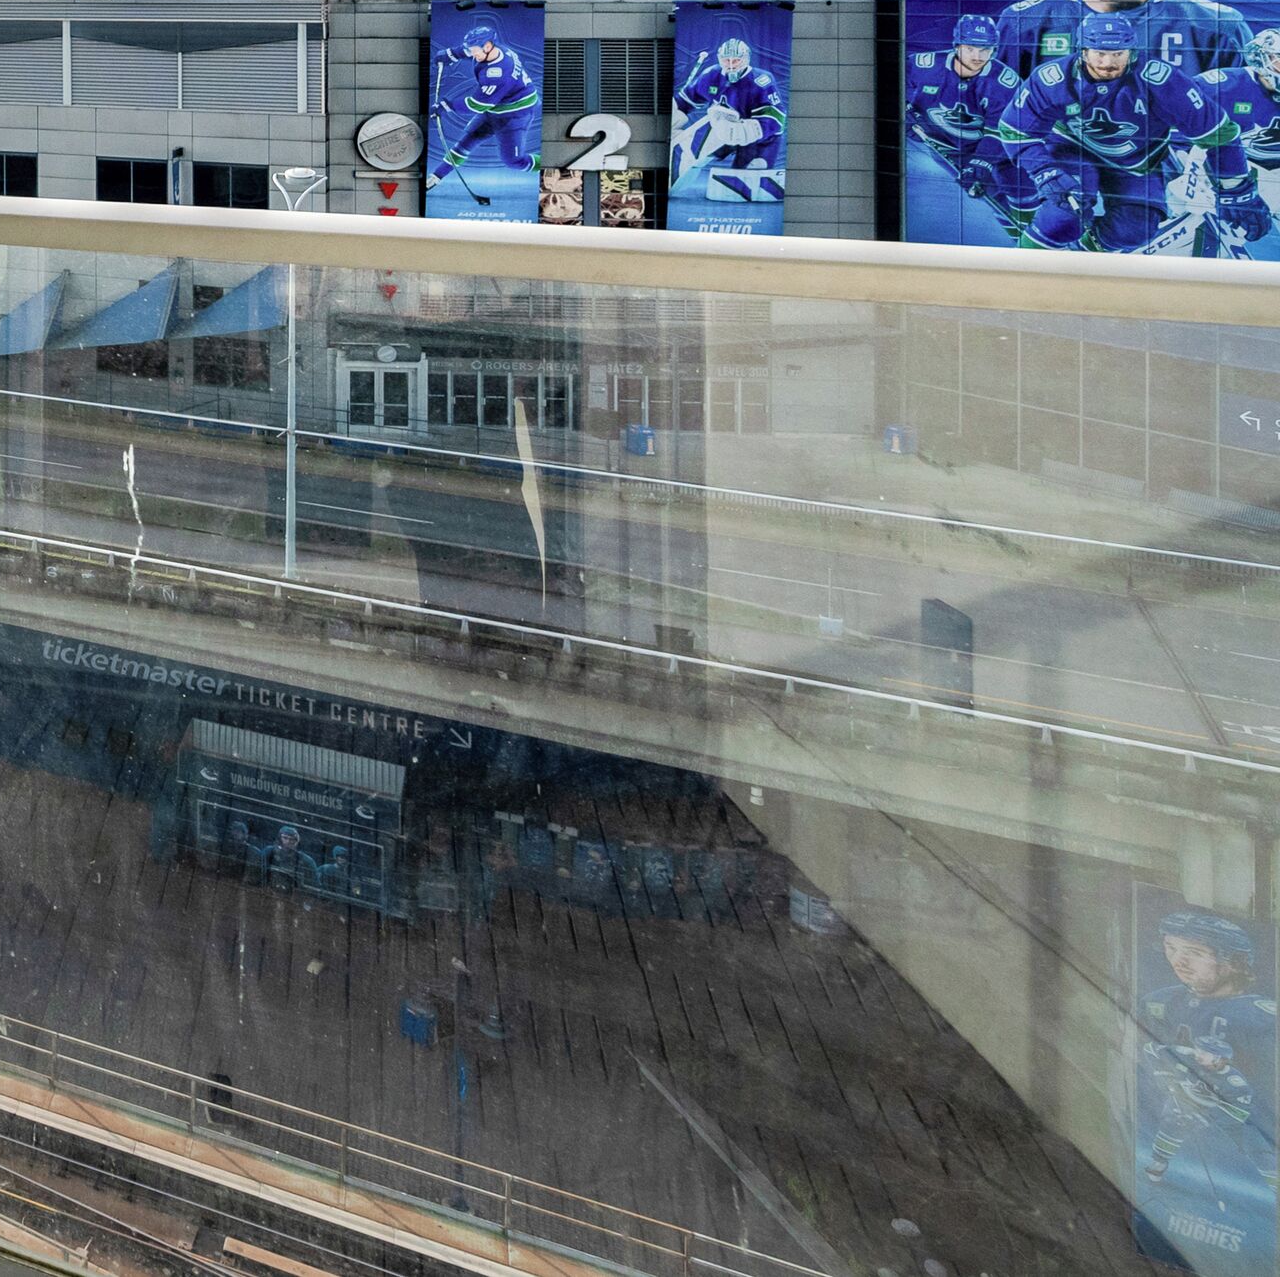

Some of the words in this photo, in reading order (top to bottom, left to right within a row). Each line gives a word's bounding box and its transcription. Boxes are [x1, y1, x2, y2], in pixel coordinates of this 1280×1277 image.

[974, 25, 986, 33] 40
[1042, 37, 1069, 52] TD
[1160, 32, 1183, 67] C
[767, 92, 781, 106] 35
[1134, 98, 1147, 115] A
[1186, 88, 1204, 110] 9
[566, 113, 632, 171] 2
[1185, 161, 1200, 200] CCM
[1142, 226, 1188, 256] CCM
[486, 361, 534, 371] ROGERS
[538, 362, 578, 372] ARENA
[41, 638, 231, 696] ticketmaster
[234, 682, 317, 716] TICKET
[330, 703, 425, 739] CENTRE
[230, 773, 290, 798] VANCOUVER
[293, 788, 344, 811] CANUCKS
[1167, 1215, 1243, 1253] HUGHES
